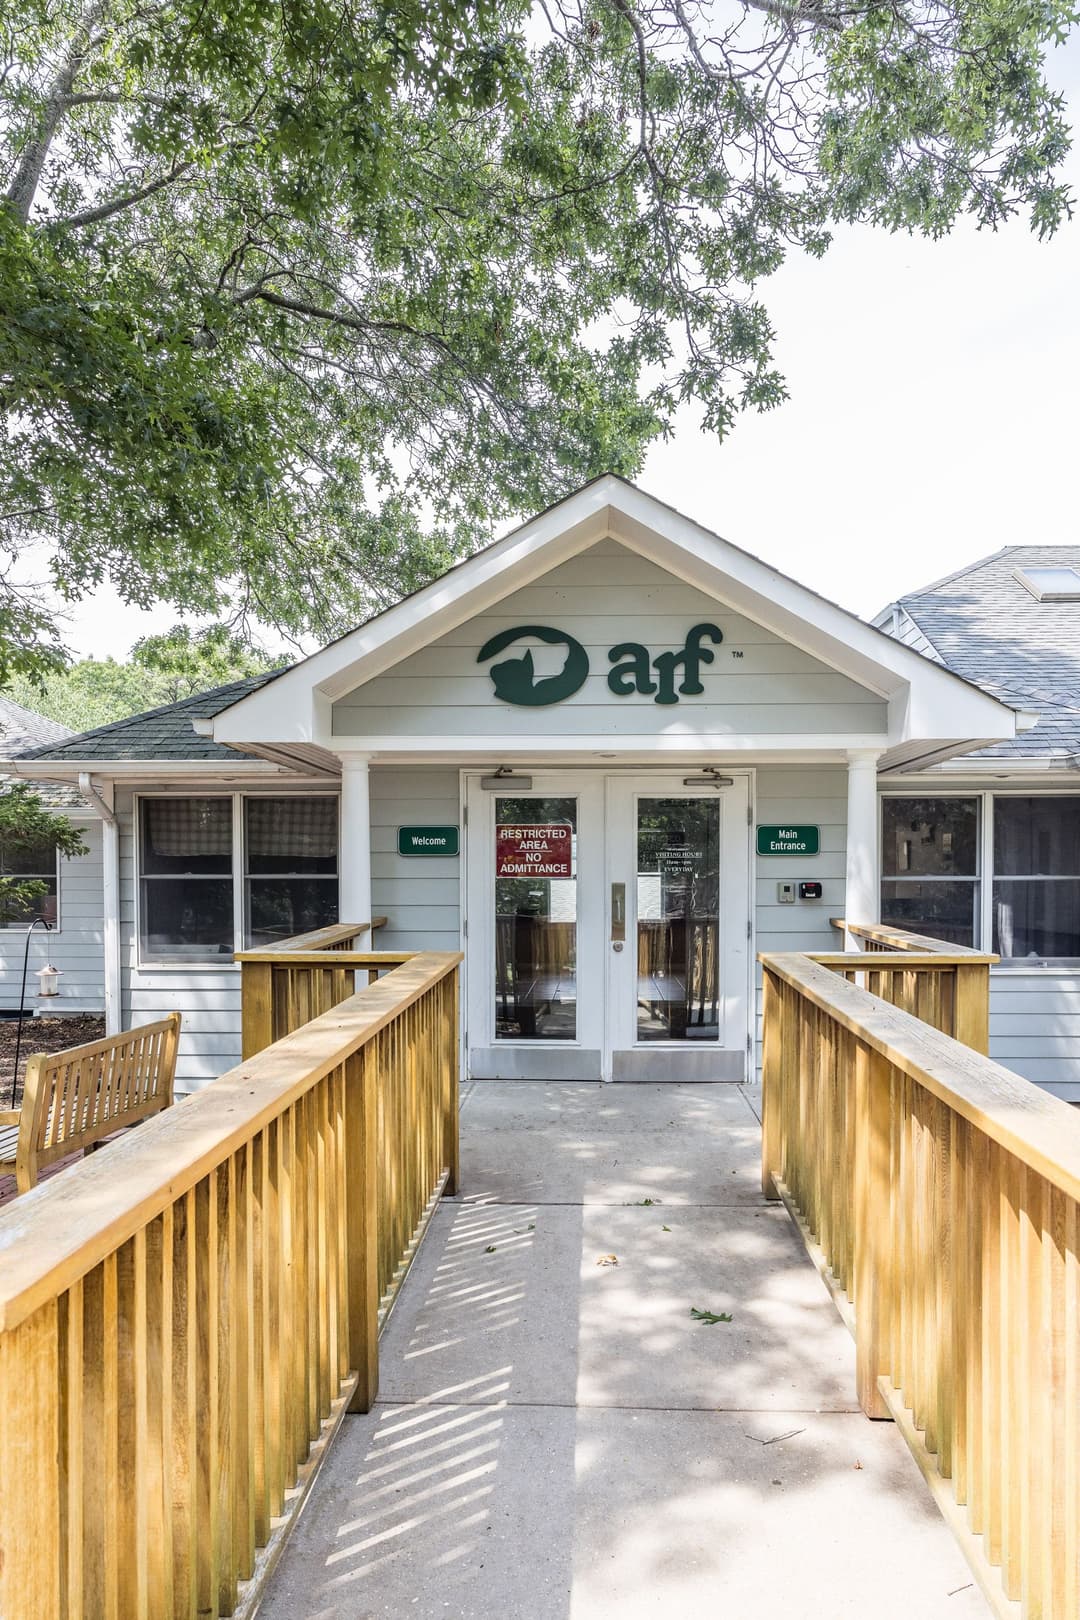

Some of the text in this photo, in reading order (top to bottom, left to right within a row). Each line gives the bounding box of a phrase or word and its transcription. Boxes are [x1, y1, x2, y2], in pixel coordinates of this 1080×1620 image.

[607, 623, 723, 704] arf
[500, 829, 567, 839] RESTRICTED
[778, 829, 798, 839] Main
[411, 836, 447, 846] Welcome
[519, 840, 549, 850] AREA
[770, 841, 806, 850] Entrance
[525, 852, 542, 862] NO
[500, 863, 568, 873] ADMITTANCE
